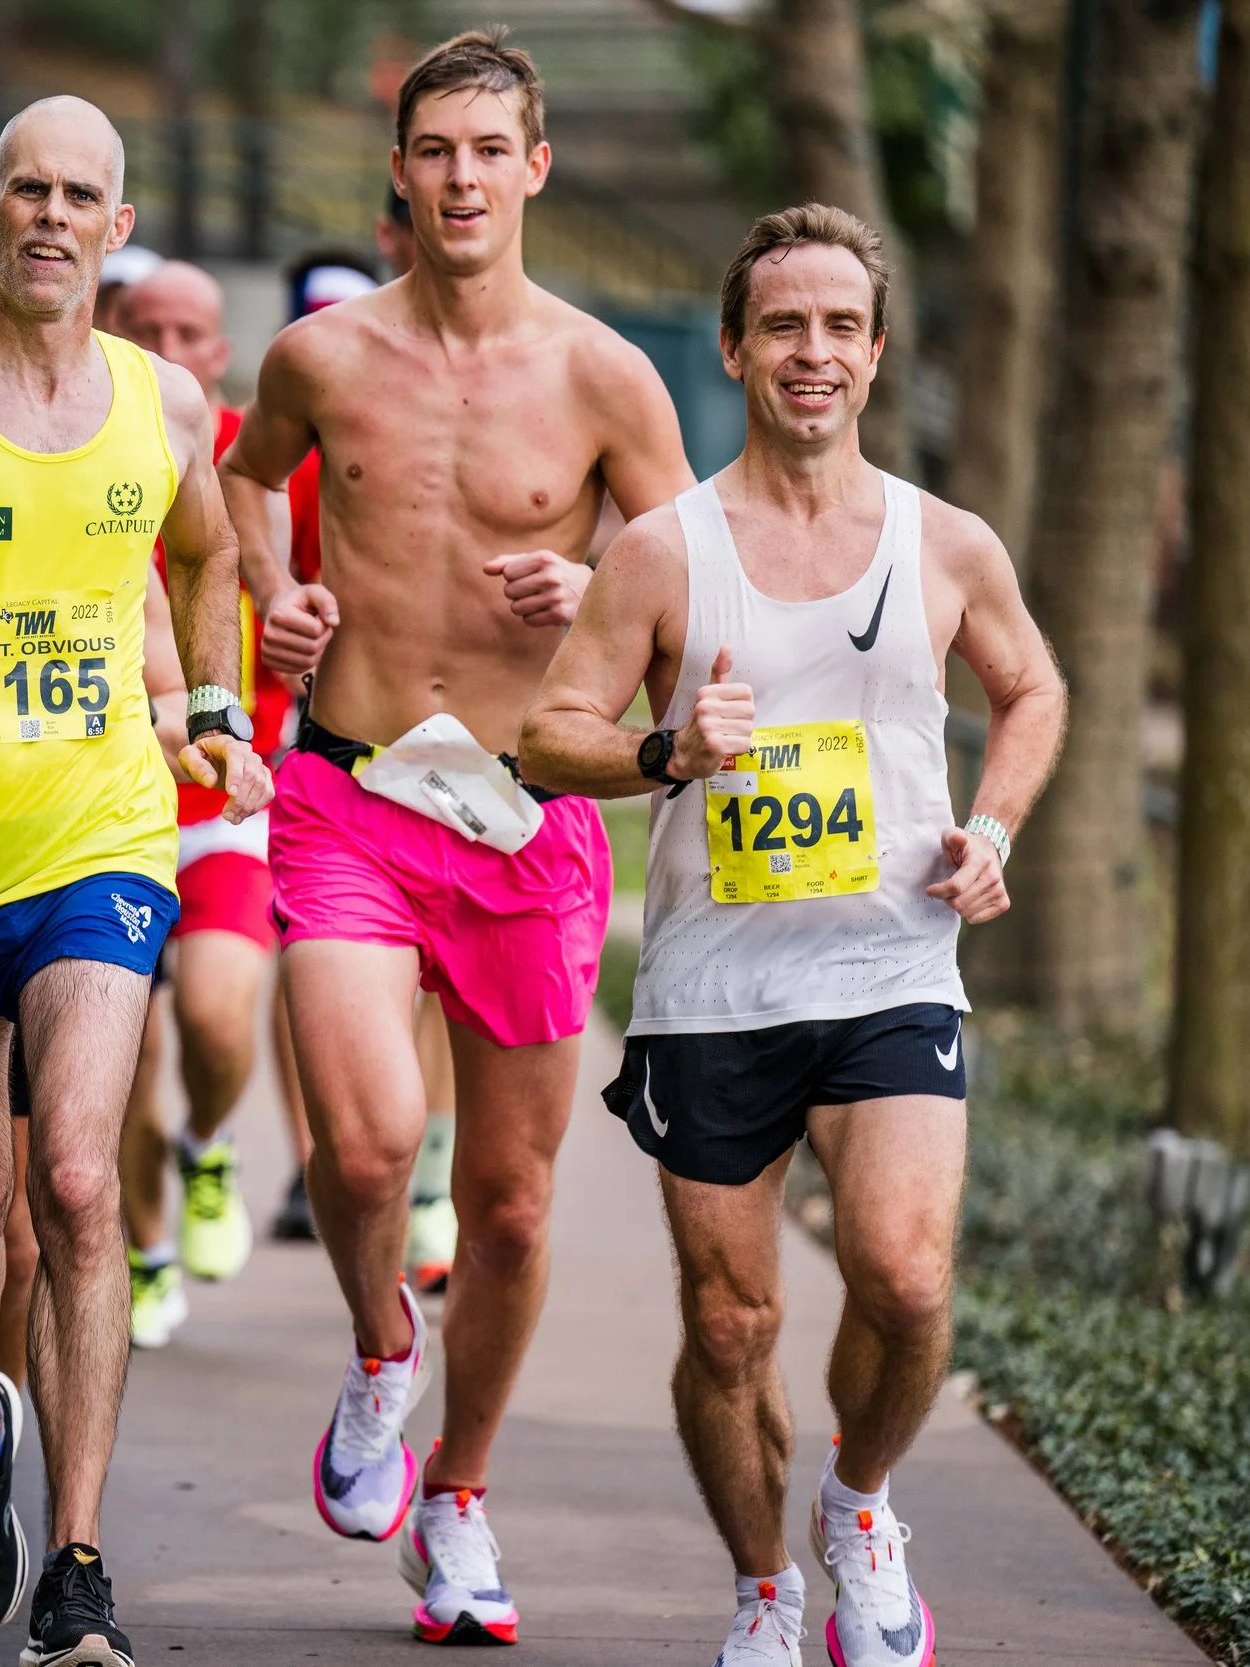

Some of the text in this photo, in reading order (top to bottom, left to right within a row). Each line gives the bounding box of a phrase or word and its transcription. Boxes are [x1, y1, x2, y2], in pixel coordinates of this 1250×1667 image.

[85, 519, 155, 537] CATAPULT
[6, 600, 30, 608] LEGACY
[71, 604, 99, 620] 2022
[105, 601, 114, 624] 1165
[15, 610, 57, 637] TWM
[21, 637, 116, 656] OBVIOUS
[91, 716, 101, 727] A
[87, 727, 104, 736] 6:55
[817, 735, 848, 752] 2022
[855, 732, 864, 754] 1294
[758, 743, 801, 770] TWM
[721, 788, 864, 852] 1294
[850, 875, 868, 883] SHIRT
